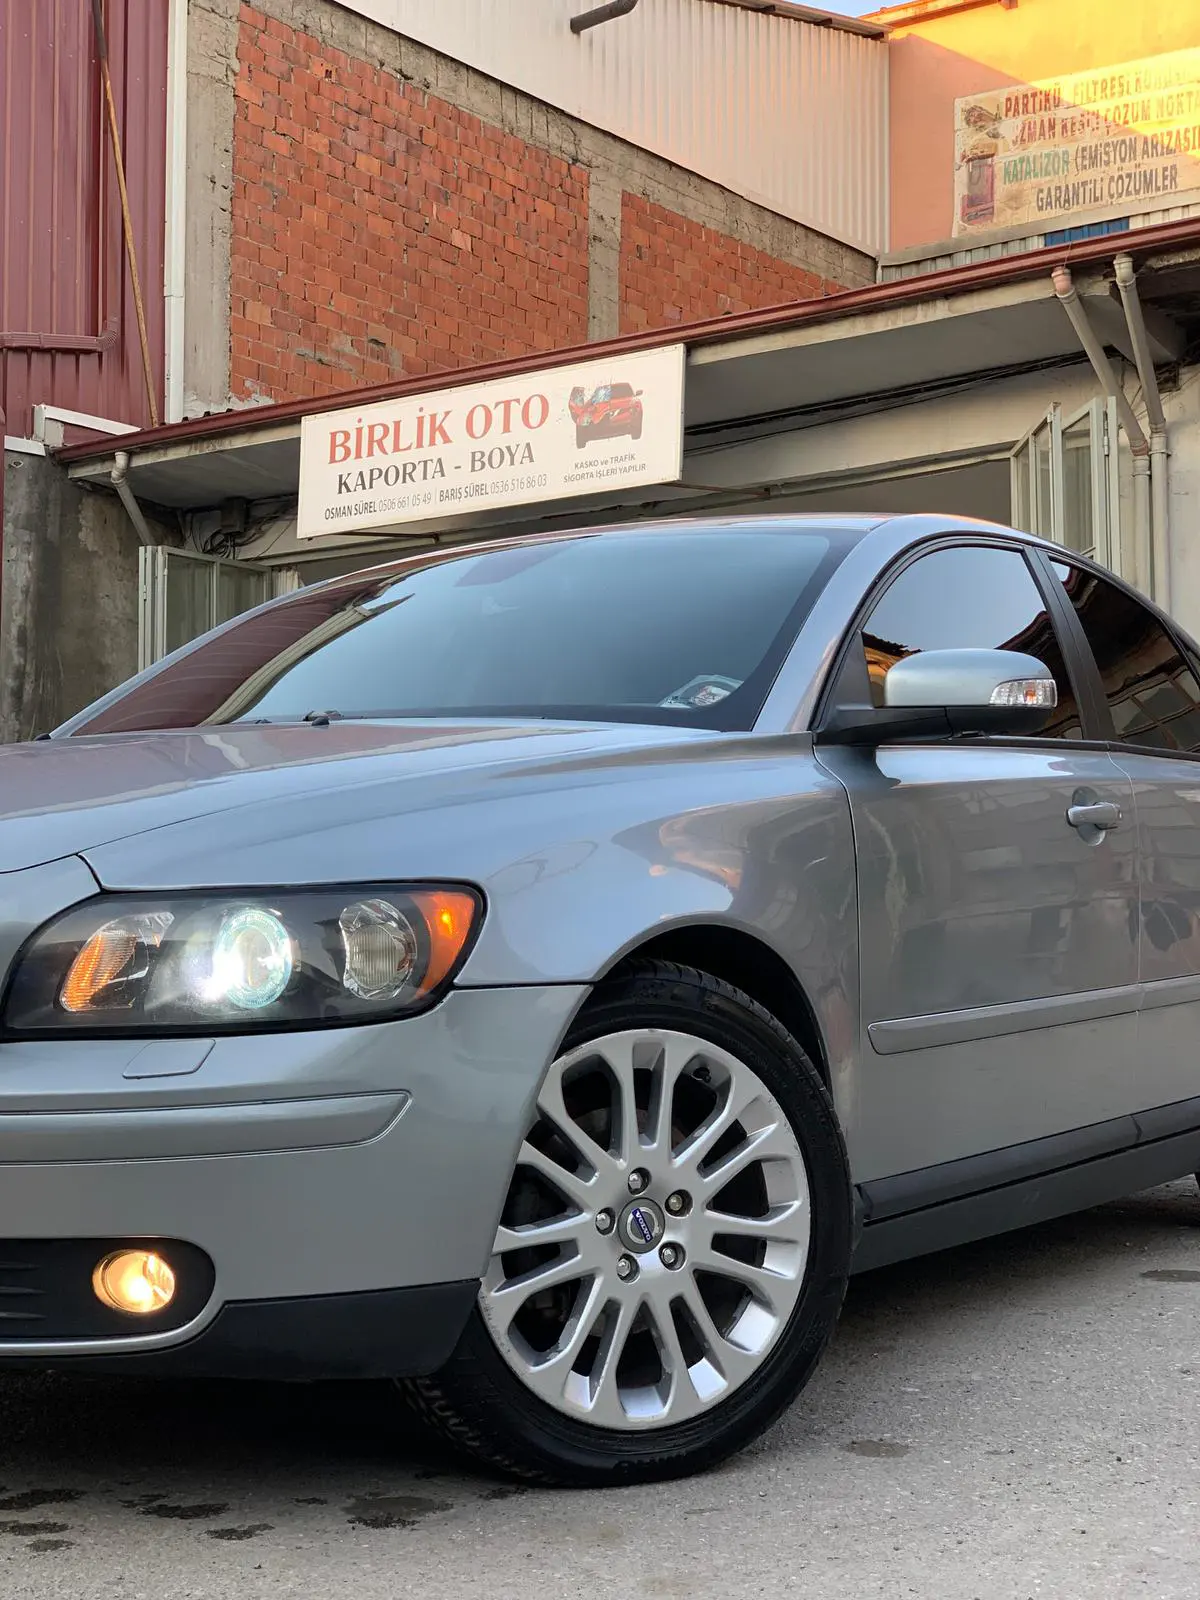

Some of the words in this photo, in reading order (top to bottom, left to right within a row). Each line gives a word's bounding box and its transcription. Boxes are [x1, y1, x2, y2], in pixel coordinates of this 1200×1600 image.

[1004, 82, 1062, 118] PARTİKÜ
[1141, 125, 1200, 160] ARIZASI
[1036, 177, 1104, 212] GARANTİLİ
[1107, 163, 1178, 206] ÇÖZÜMLER
[328, 406, 452, 465] BİRLİK
[465, 393, 550, 440] OTO
[337, 457, 446, 495] KAPORTA
[469, 441, 536, 473] BOYA
[563, 471, 594, 483] SİGORTA
[595, 467, 618, 479] İŞLERİ
[619, 463, 646, 474] YAPILIR
[574, 459, 599, 470] KASKO
[610, 451, 636, 465] TRAFİK
[324, 504, 353, 520] OSMAN
[353, 499, 377, 516] SÜREL
[378, 498, 396, 513] 0506
[439, 487, 462, 502] BARIŞ
[464, 483, 489, 499] SÜREL
[490, 480, 510, 495] 0536
[537, 473, 547, 487] 03
[635, 1210, 651, 1241] VOLVO
